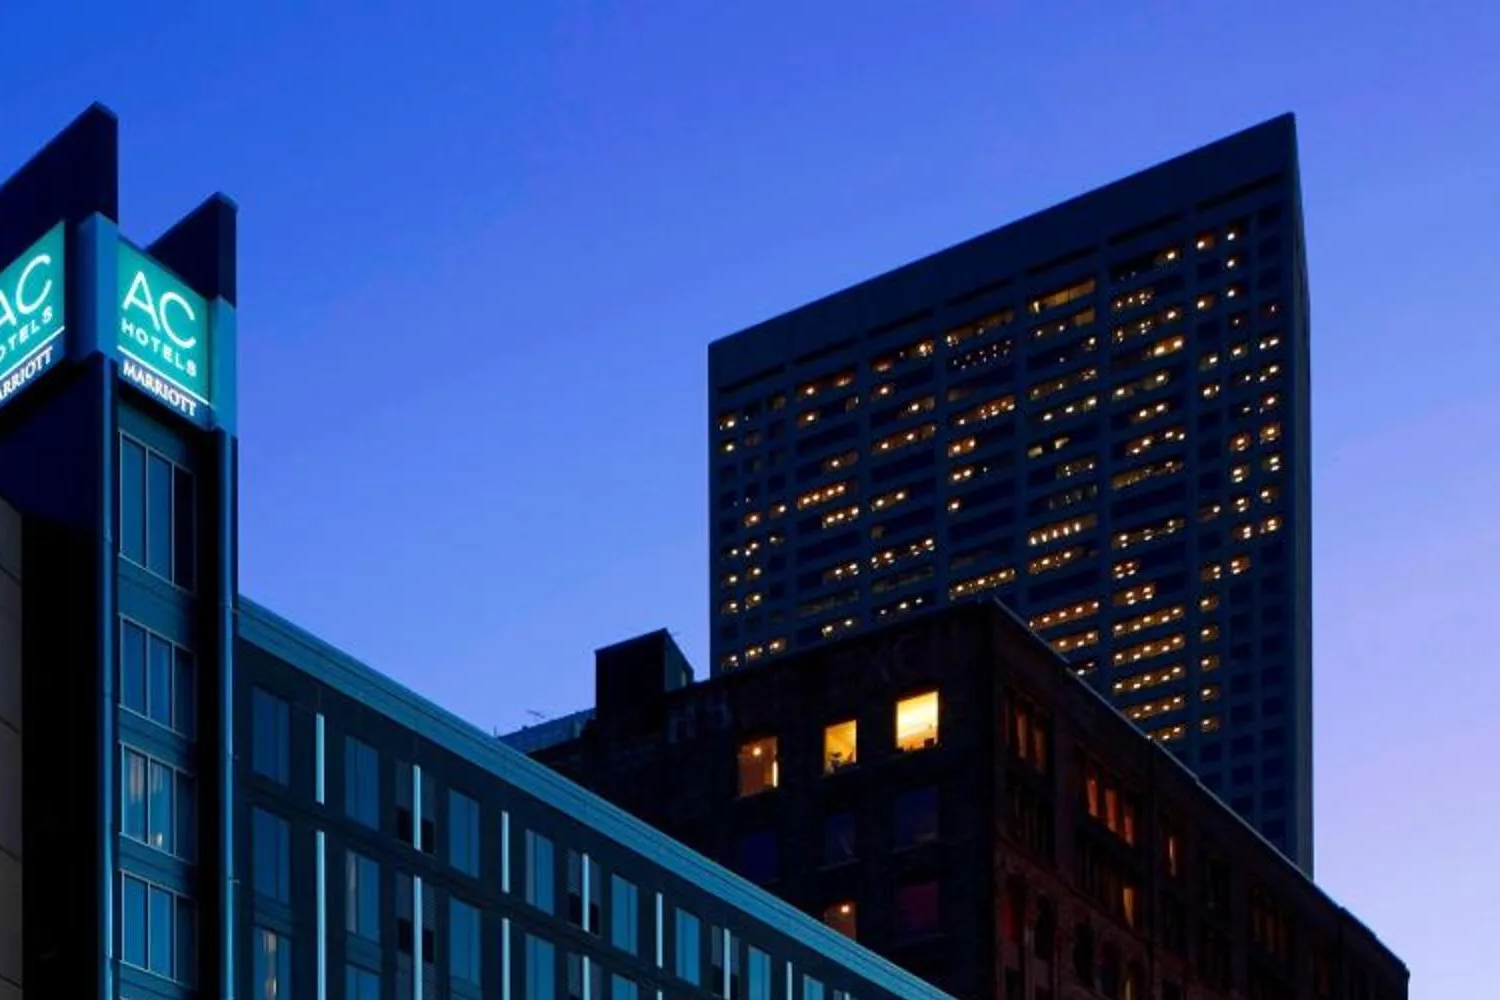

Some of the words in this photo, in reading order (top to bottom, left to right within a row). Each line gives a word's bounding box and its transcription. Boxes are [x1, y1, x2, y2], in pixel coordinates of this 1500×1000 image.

[122, 271, 197, 348] AC
[121, 317, 197, 378] HOTELS
[122, 360, 197, 416] MARRIOTT
